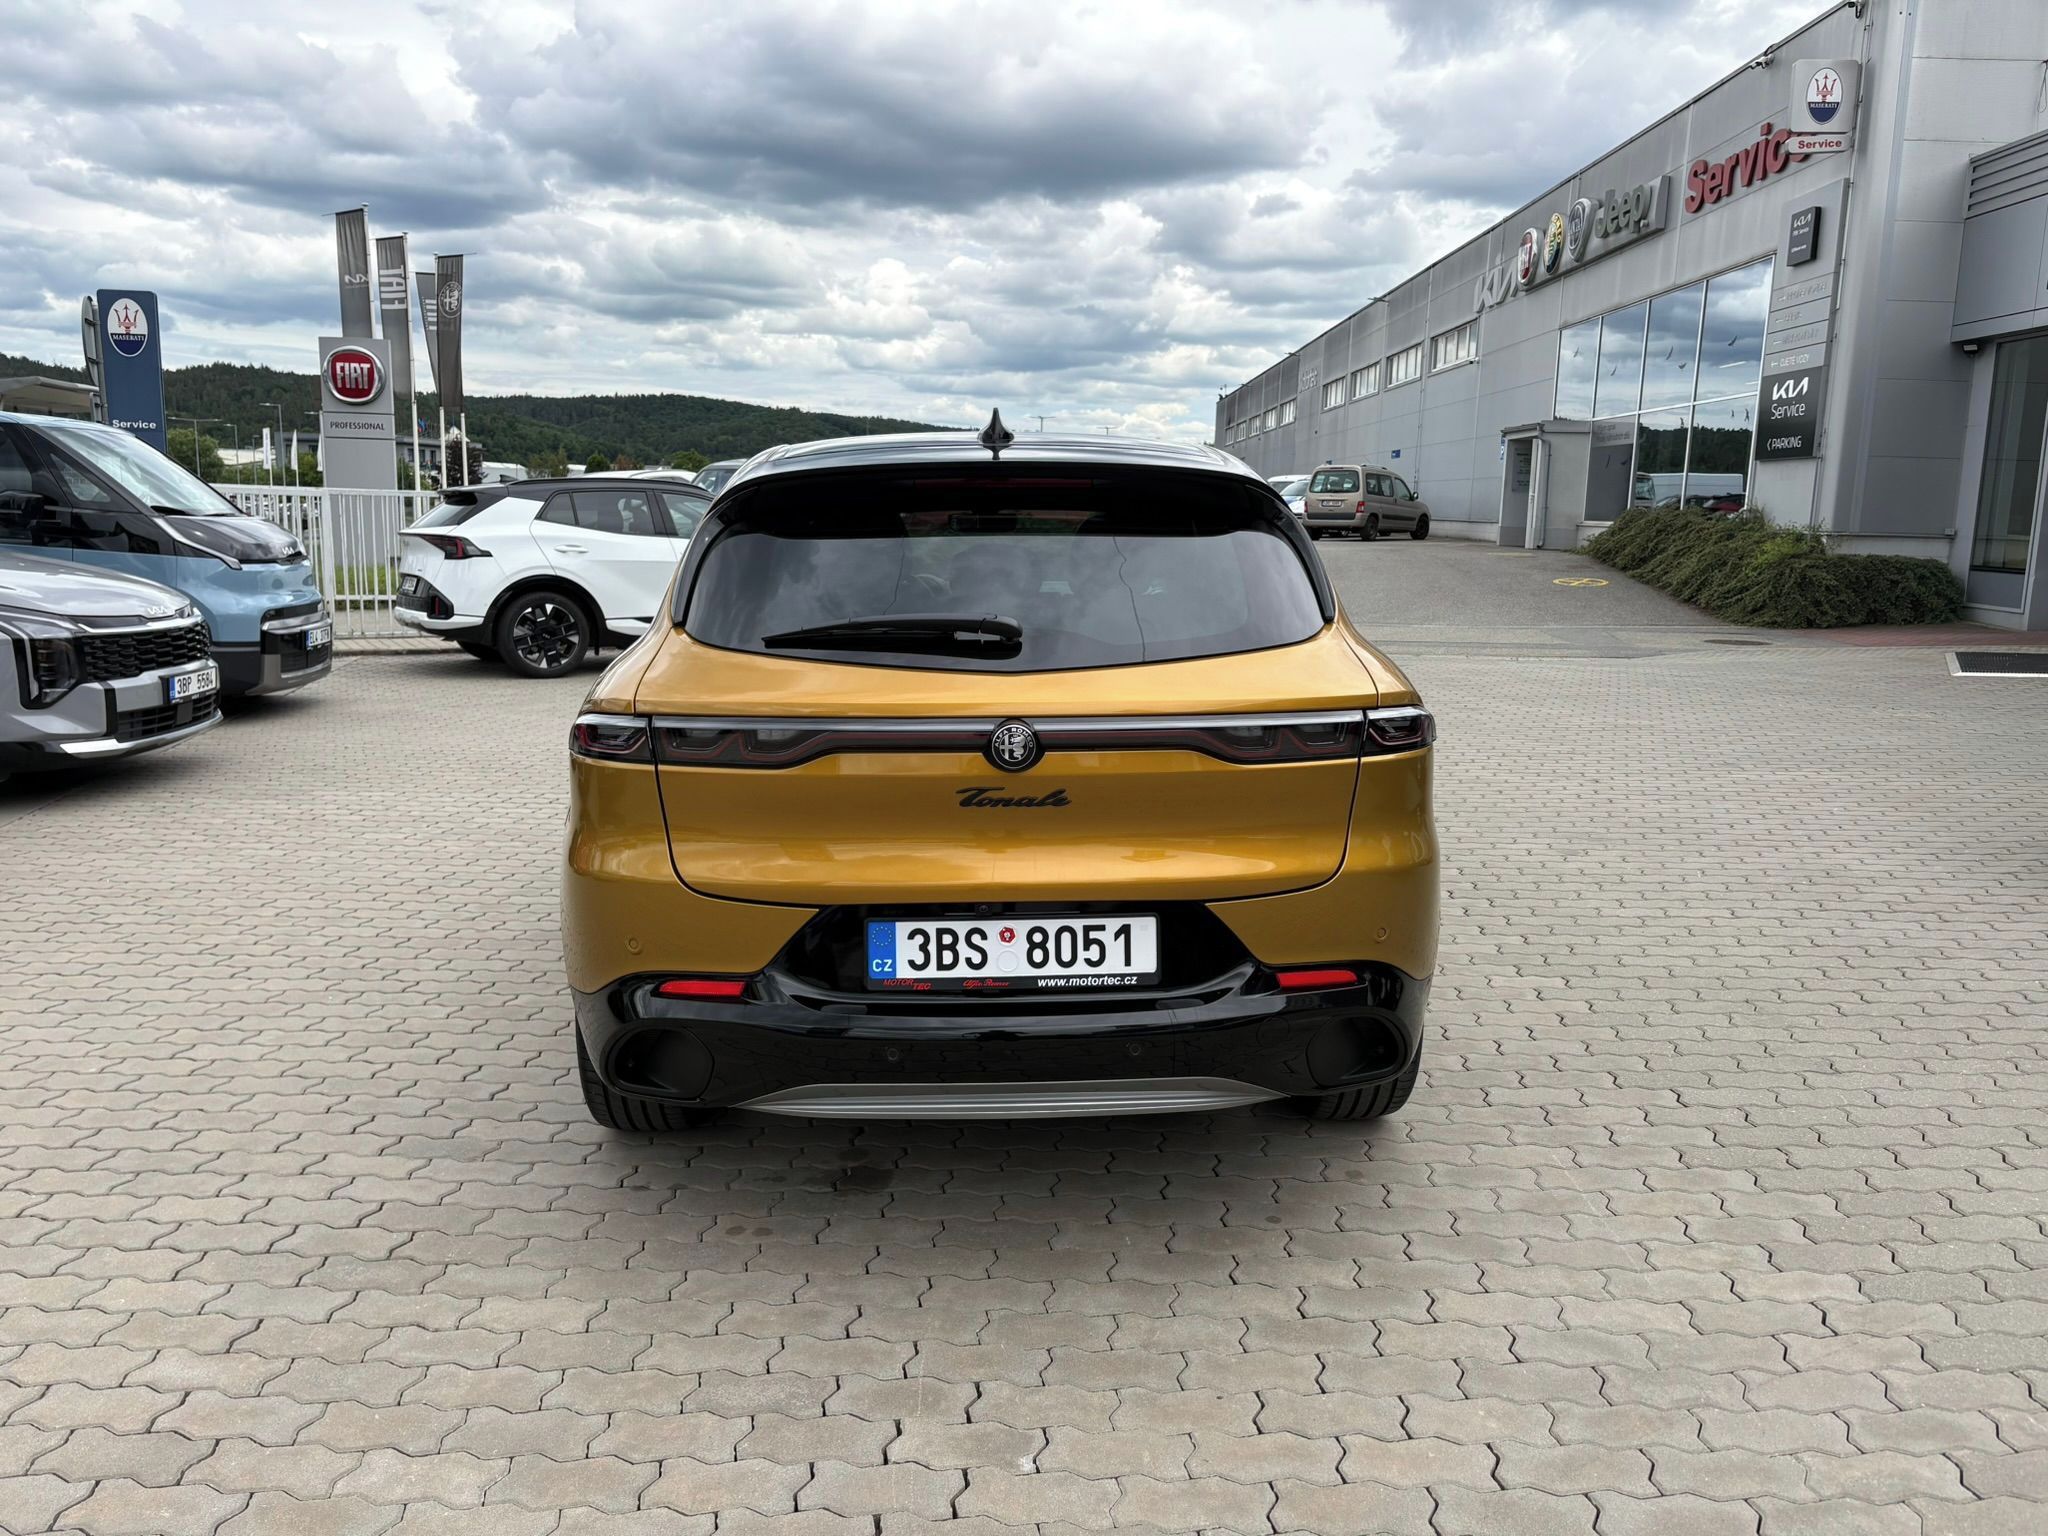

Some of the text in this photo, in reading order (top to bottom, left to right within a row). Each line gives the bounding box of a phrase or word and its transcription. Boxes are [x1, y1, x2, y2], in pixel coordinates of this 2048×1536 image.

[1798, 138, 1843, 150] Service
[1594, 185, 1652, 238] Jeep
[335, 362, 371, 389] FIAT
[1772, 376, 1809, 400] KIA
[1770, 402, 1805, 420] Service
[112, 419, 157, 430] Service
[330, 421, 385, 431] PROFESSIONAL
[1772, 435, 1802, 450] PARKING
[177, 676, 192, 695] 3BP
[994, 727, 1034, 748] ALFA ROMEO
[955, 786, 1072, 807] Tonale
[907, 923, 1132, 971] 3BS 8051
[872, 958, 893, 972] CZ
[883, 978, 932, 990] MOTOR TEC
[1037, 975, 1138, 988] www.motortec.cz
